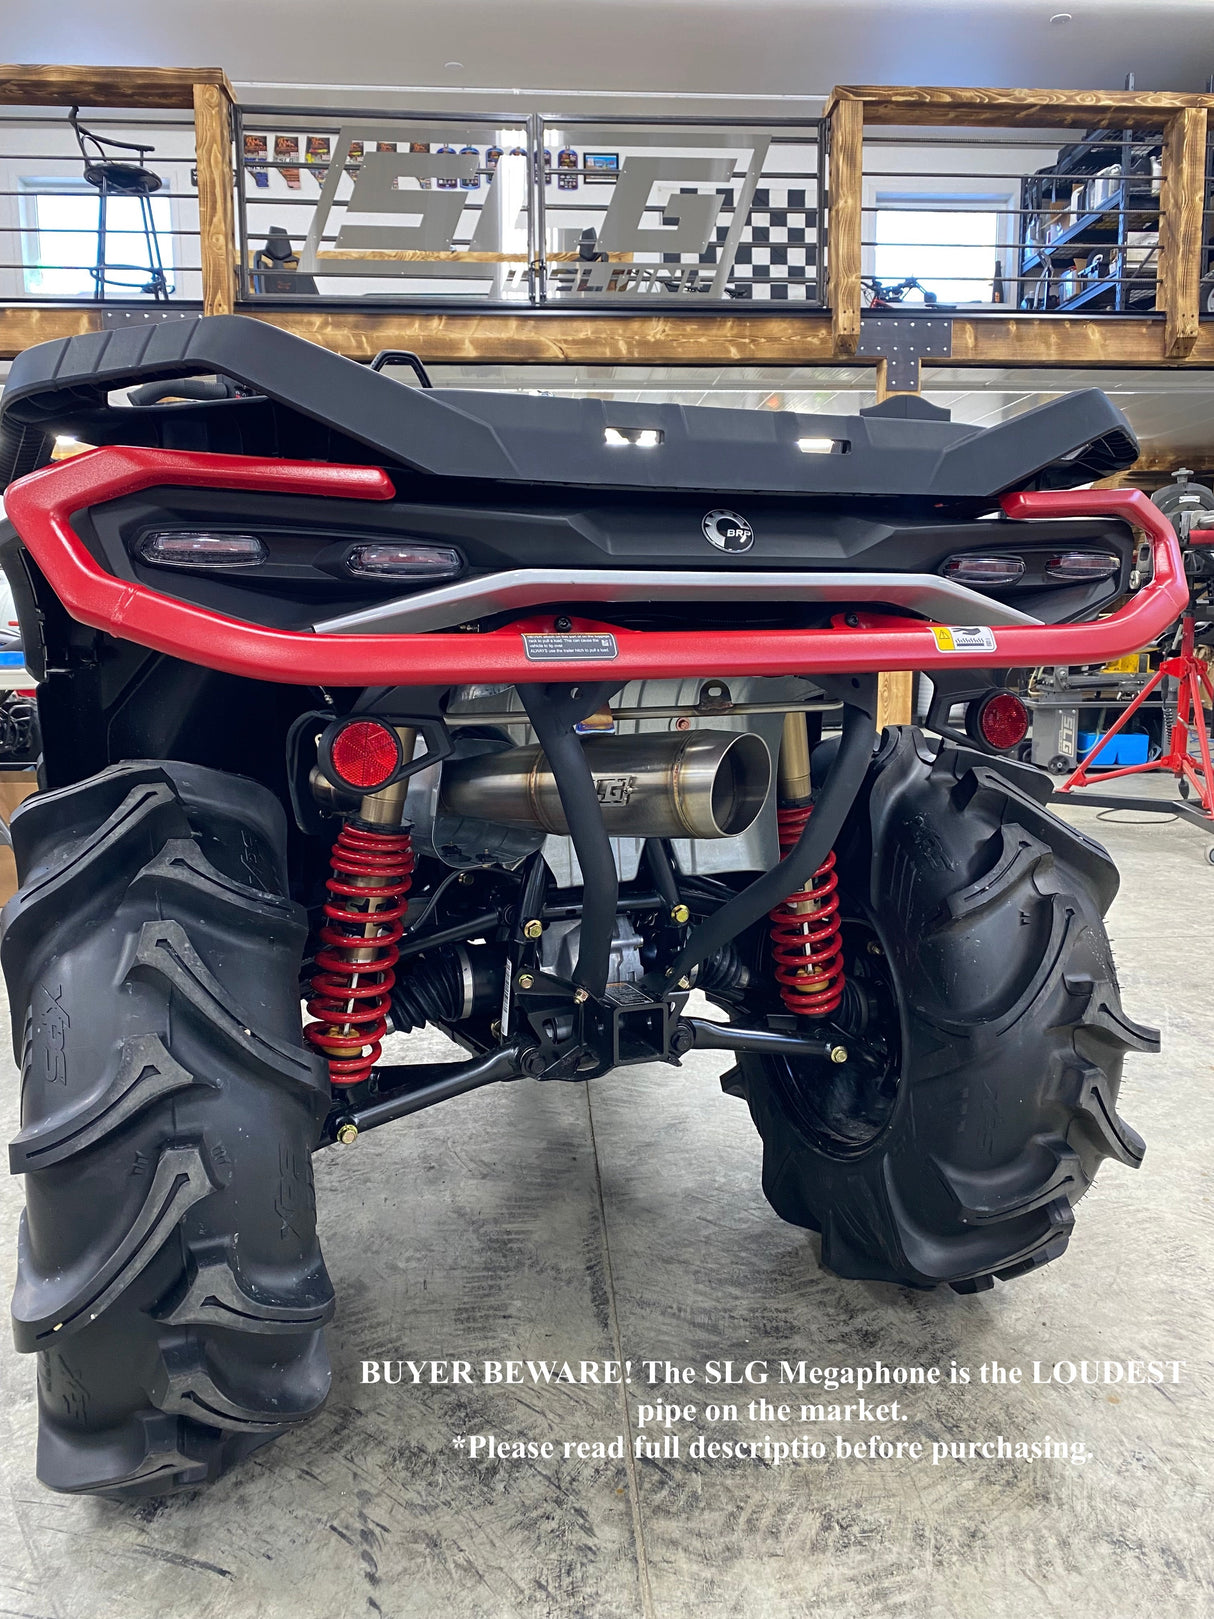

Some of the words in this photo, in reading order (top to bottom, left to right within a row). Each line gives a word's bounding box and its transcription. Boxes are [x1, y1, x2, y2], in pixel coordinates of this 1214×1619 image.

[335, 152, 738, 254] SLG
[727, 529, 751, 543] BRP
[1062, 715, 1074, 755] SLG
